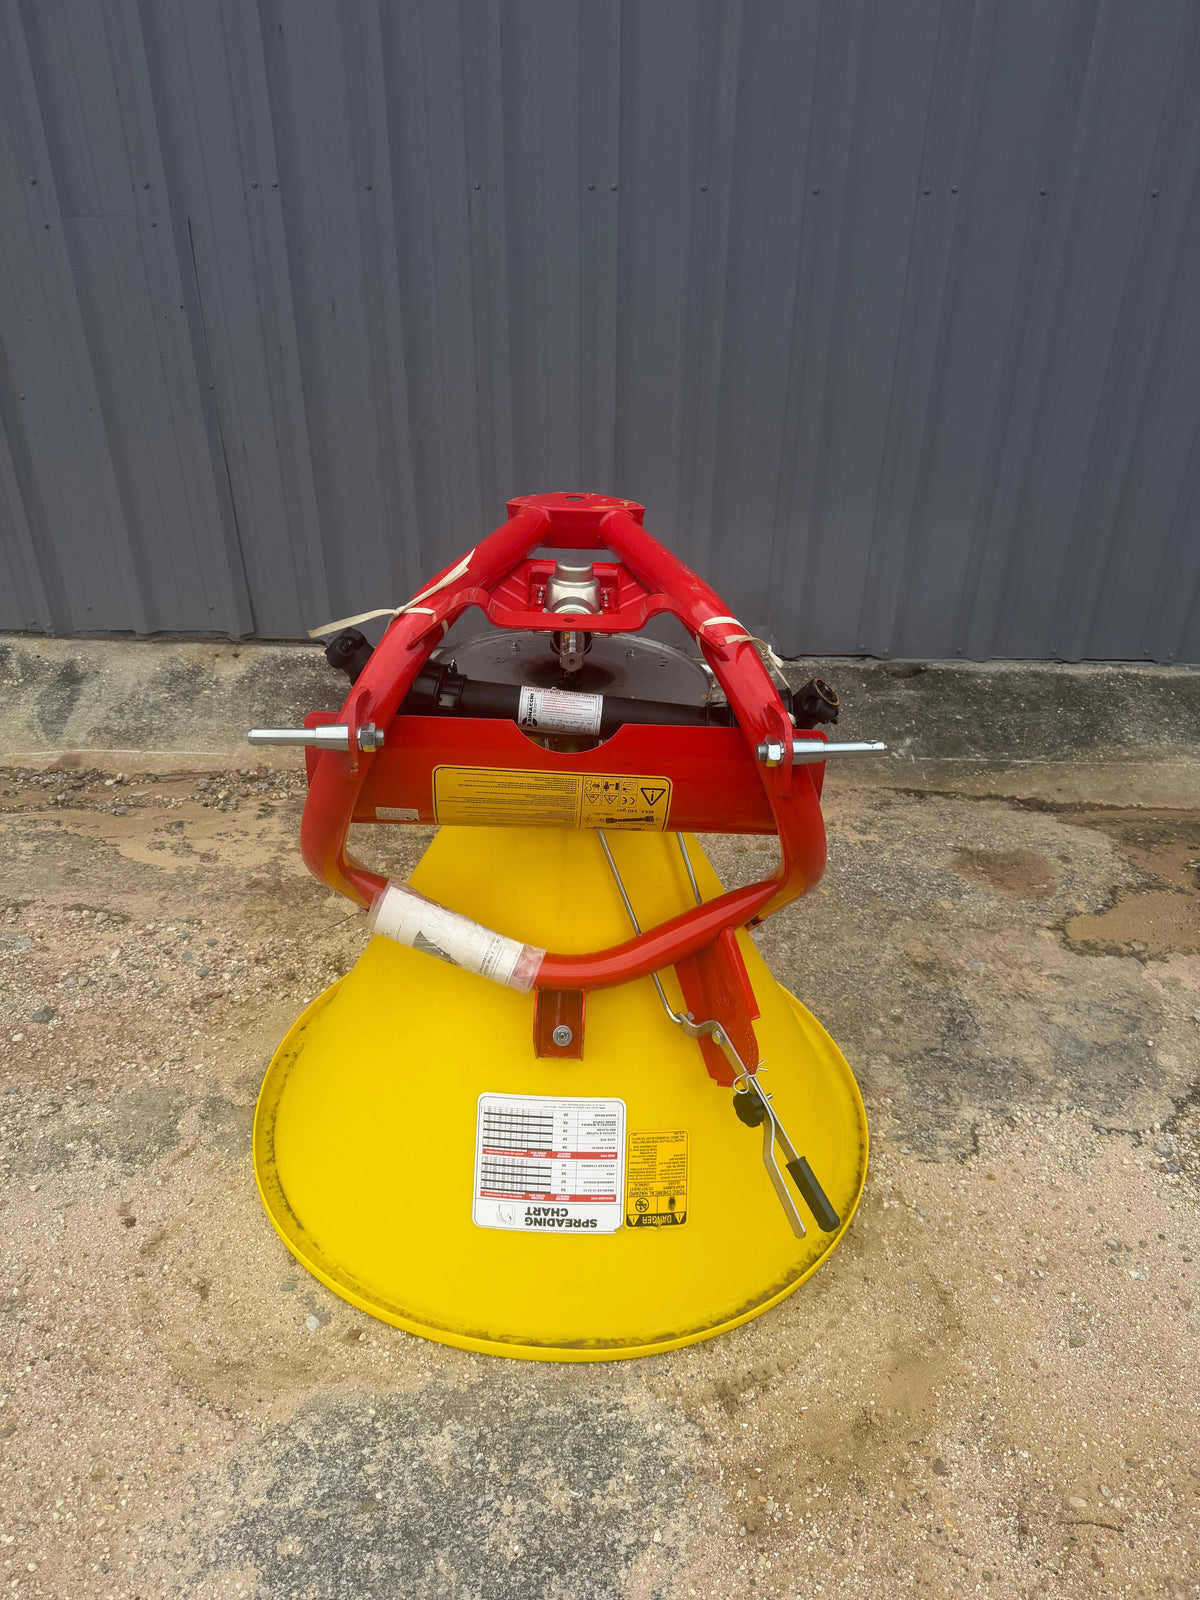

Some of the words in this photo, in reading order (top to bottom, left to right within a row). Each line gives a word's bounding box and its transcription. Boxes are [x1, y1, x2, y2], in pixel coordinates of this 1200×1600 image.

[525, 1207, 568, 1217] CHART
[525, 1217, 597, 1228] SPREADING
[642, 1215, 672, 1224] DANGER
